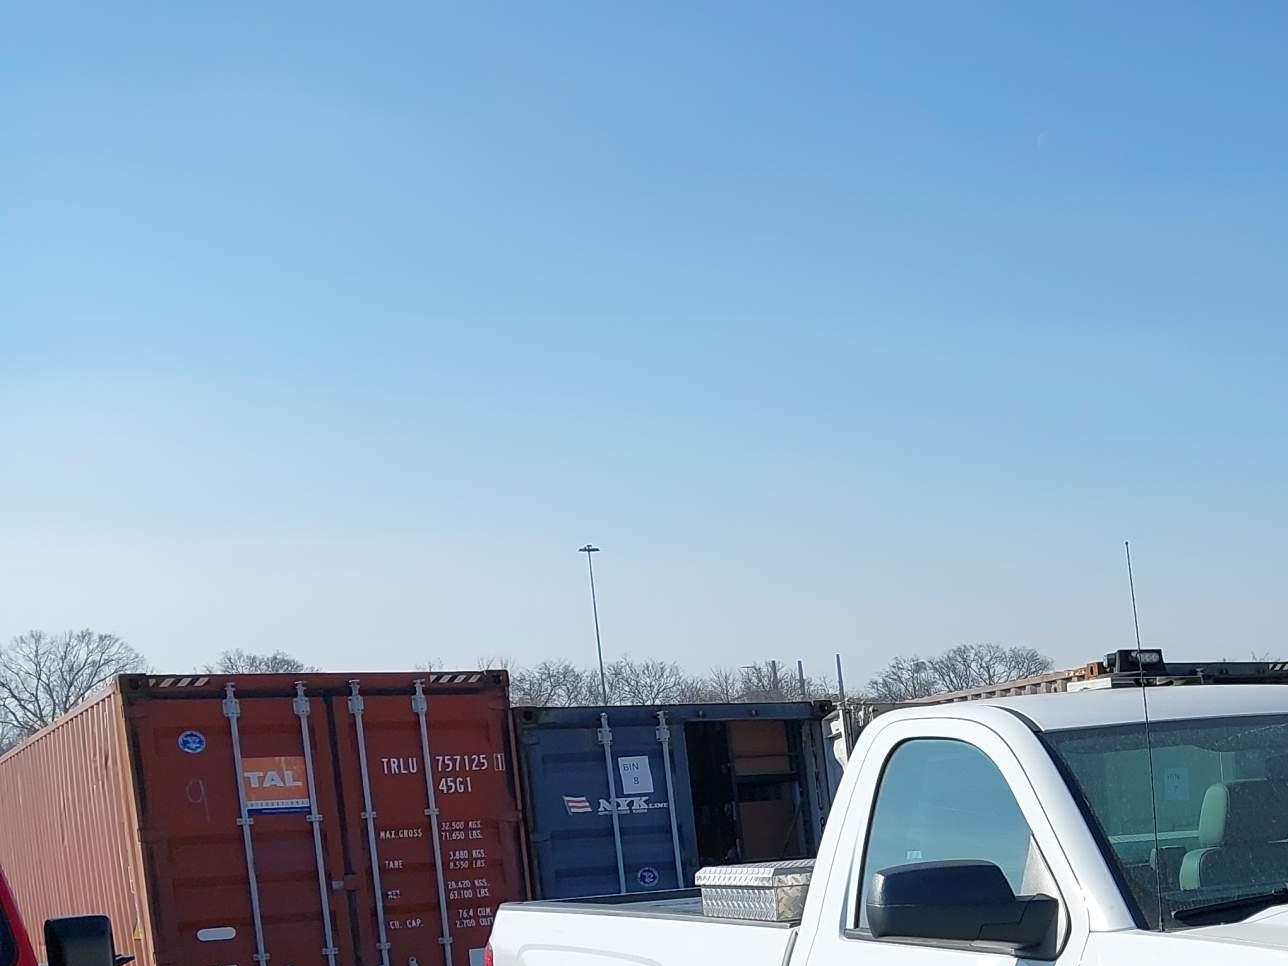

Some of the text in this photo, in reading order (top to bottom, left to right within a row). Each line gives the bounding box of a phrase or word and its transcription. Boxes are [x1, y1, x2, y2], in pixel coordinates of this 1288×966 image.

[381, 757, 417, 774] TRLU
[435, 754, 488, 772] 757125
[623, 762, 639, 771] BIN
[243, 770, 303, 788] TAL
[439, 777, 472, 793] 45G1
[598, 796, 649, 811] NYK
[385, 860, 403, 870] TARE
